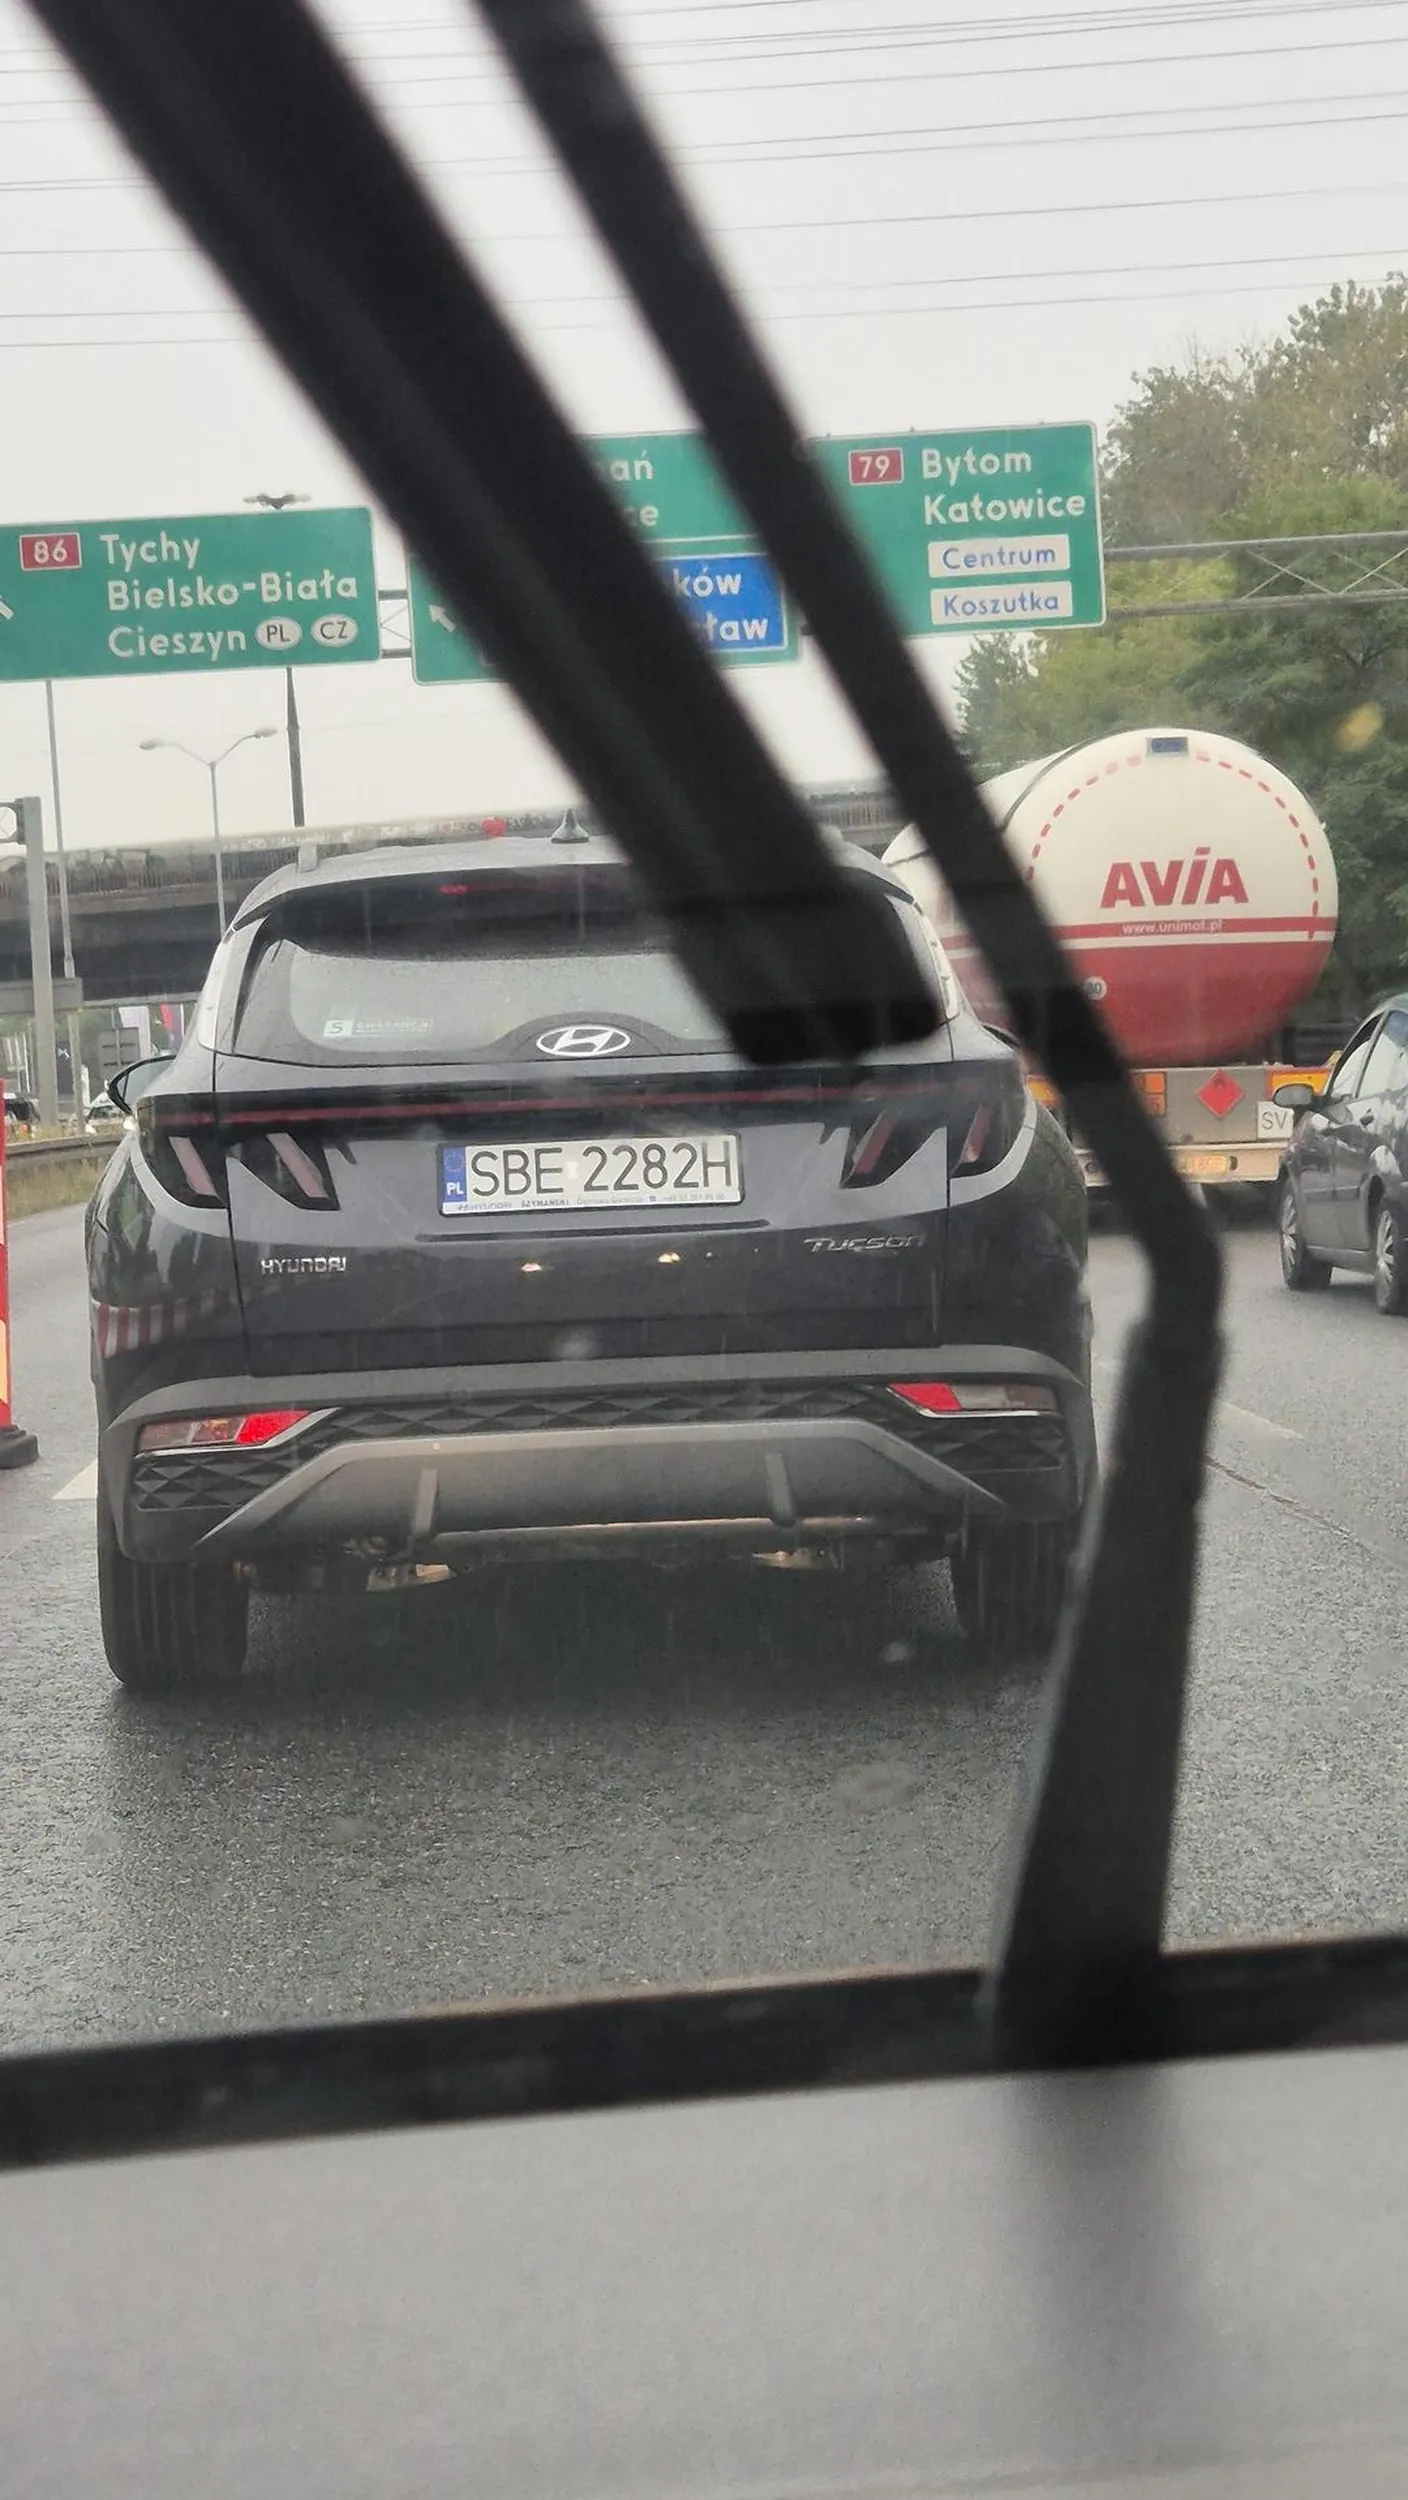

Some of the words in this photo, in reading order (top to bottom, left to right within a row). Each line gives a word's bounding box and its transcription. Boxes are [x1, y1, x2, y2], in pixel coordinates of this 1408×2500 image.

[859, 456, 890, 478] 79
[921, 447, 1032, 486] Bytom
[924, 488, 1086, 525] Katowice
[33, 540, 68, 563] 86
[100, 531, 200, 572] Tychy
[942, 546, 1056, 570] Centrum
[107, 569, 358, 611] Bielsko-Biała
[943, 590, 1059, 617] Koszutka
[108, 625, 247, 661] Cieszyn
[266, 623, 291, 644] PL
[319, 620, 347, 640] CZ
[1122, 919, 1223, 935] www.unimot.pl
[471, 1148, 565, 1197] SBE
[582, 1140, 732, 1193] 2282H
[446, 1181, 465, 1196] PL
[804, 1235, 925, 1252] TUCSON
[261, 1256, 347, 1274] HYUNDAI
